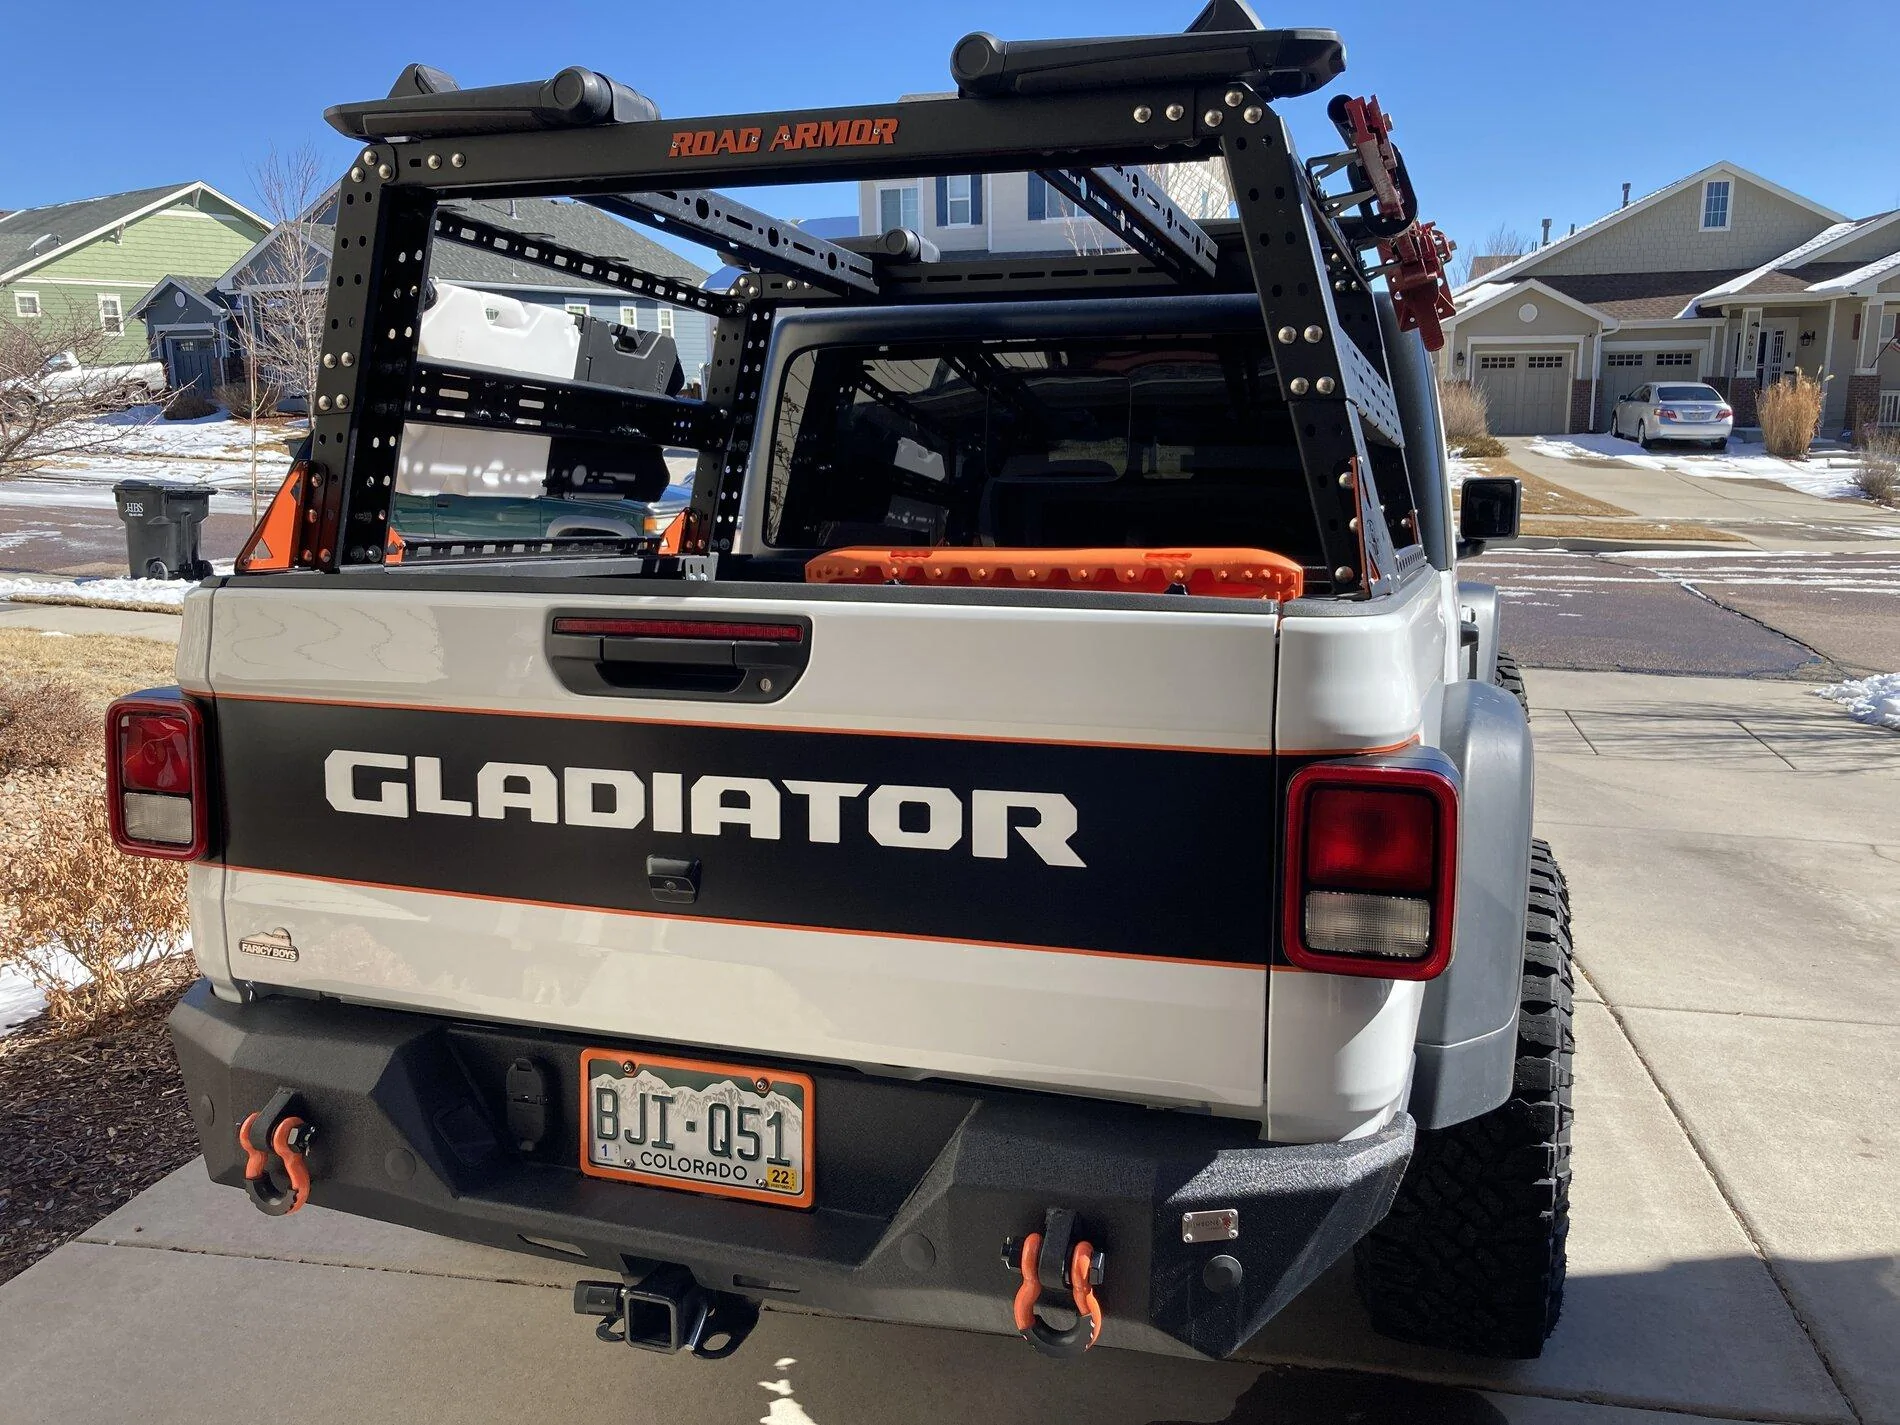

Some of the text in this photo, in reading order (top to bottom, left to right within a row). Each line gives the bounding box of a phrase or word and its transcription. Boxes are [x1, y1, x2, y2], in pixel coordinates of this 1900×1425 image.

[668, 118, 899, 157] ROAD ARMOR
[324, 749, 1087, 867] GLADIATOR
[273, 948, 297, 960] BOYS
[601, 1144, 608, 1157] 1
[640, 1151, 748, 1181] COLORADO
[771, 1169, 790, 1184] 22
